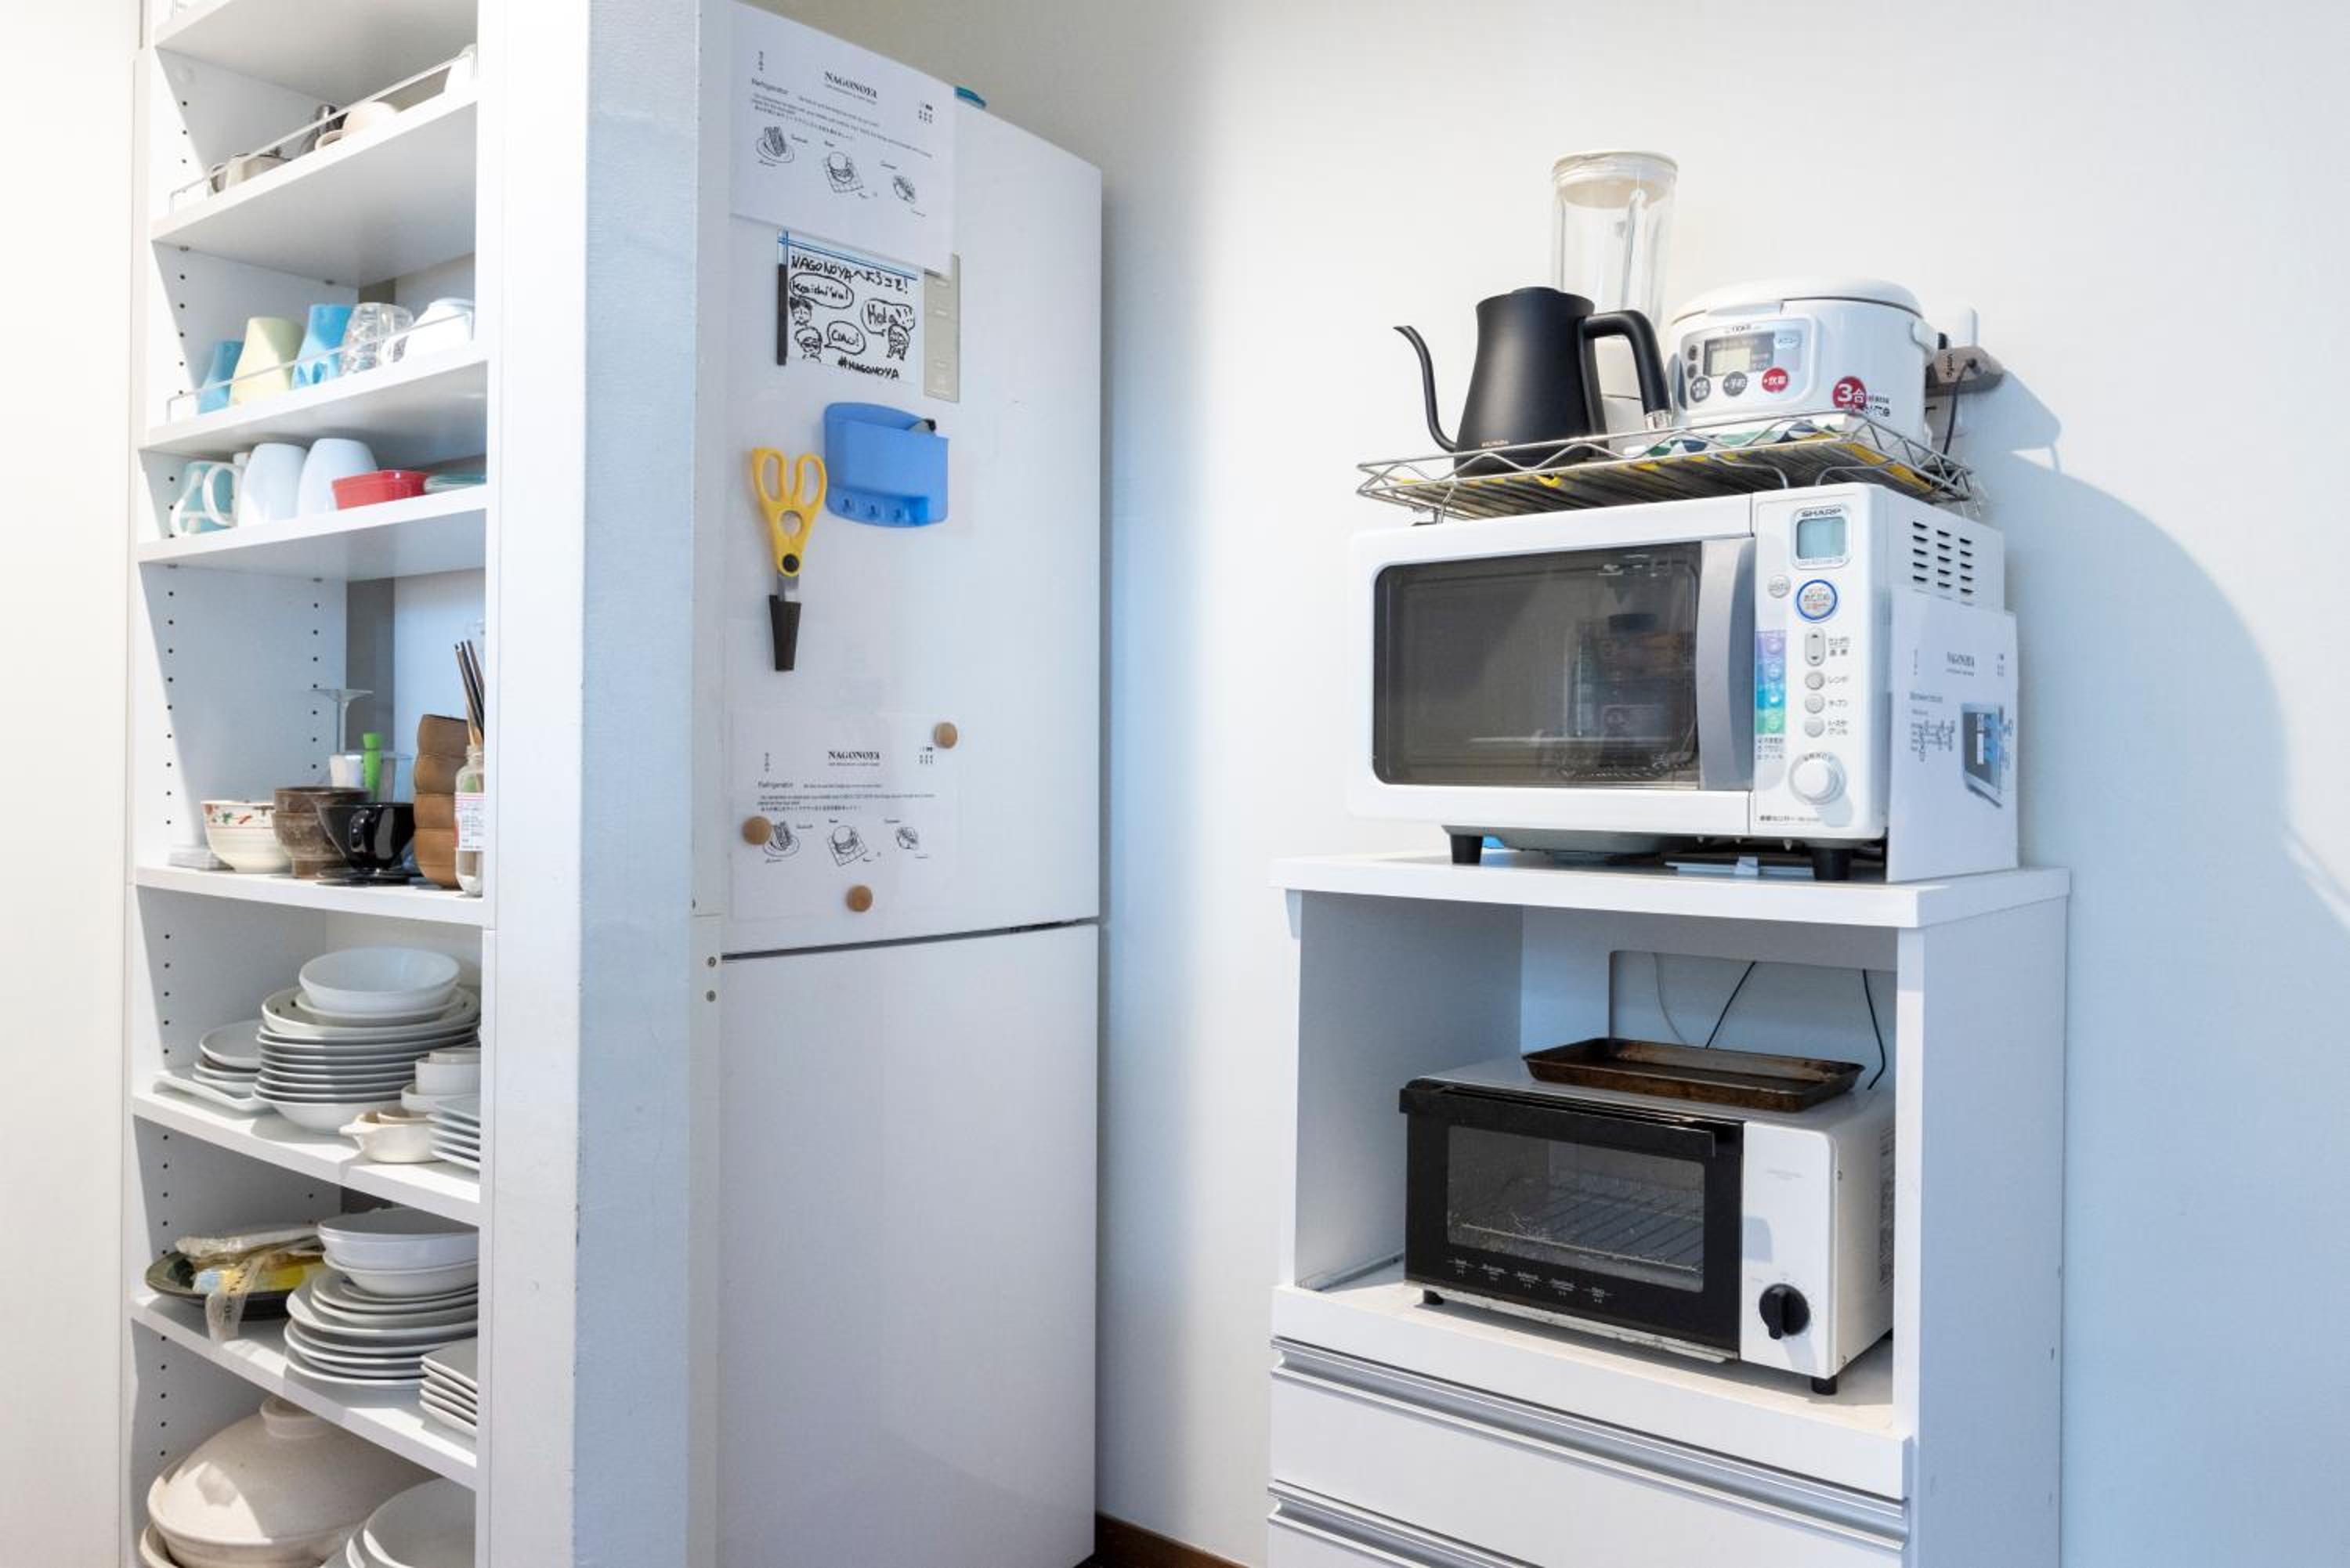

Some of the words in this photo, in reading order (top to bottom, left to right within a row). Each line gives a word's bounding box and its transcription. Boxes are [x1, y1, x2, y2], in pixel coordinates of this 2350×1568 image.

[824, 71, 877, 99] NAGONOYA
[837, 356, 900, 380] #NAGONOYA
[1801, 508, 1842, 518] SHARP
[827, 750, 880, 761] NAGONOYA
